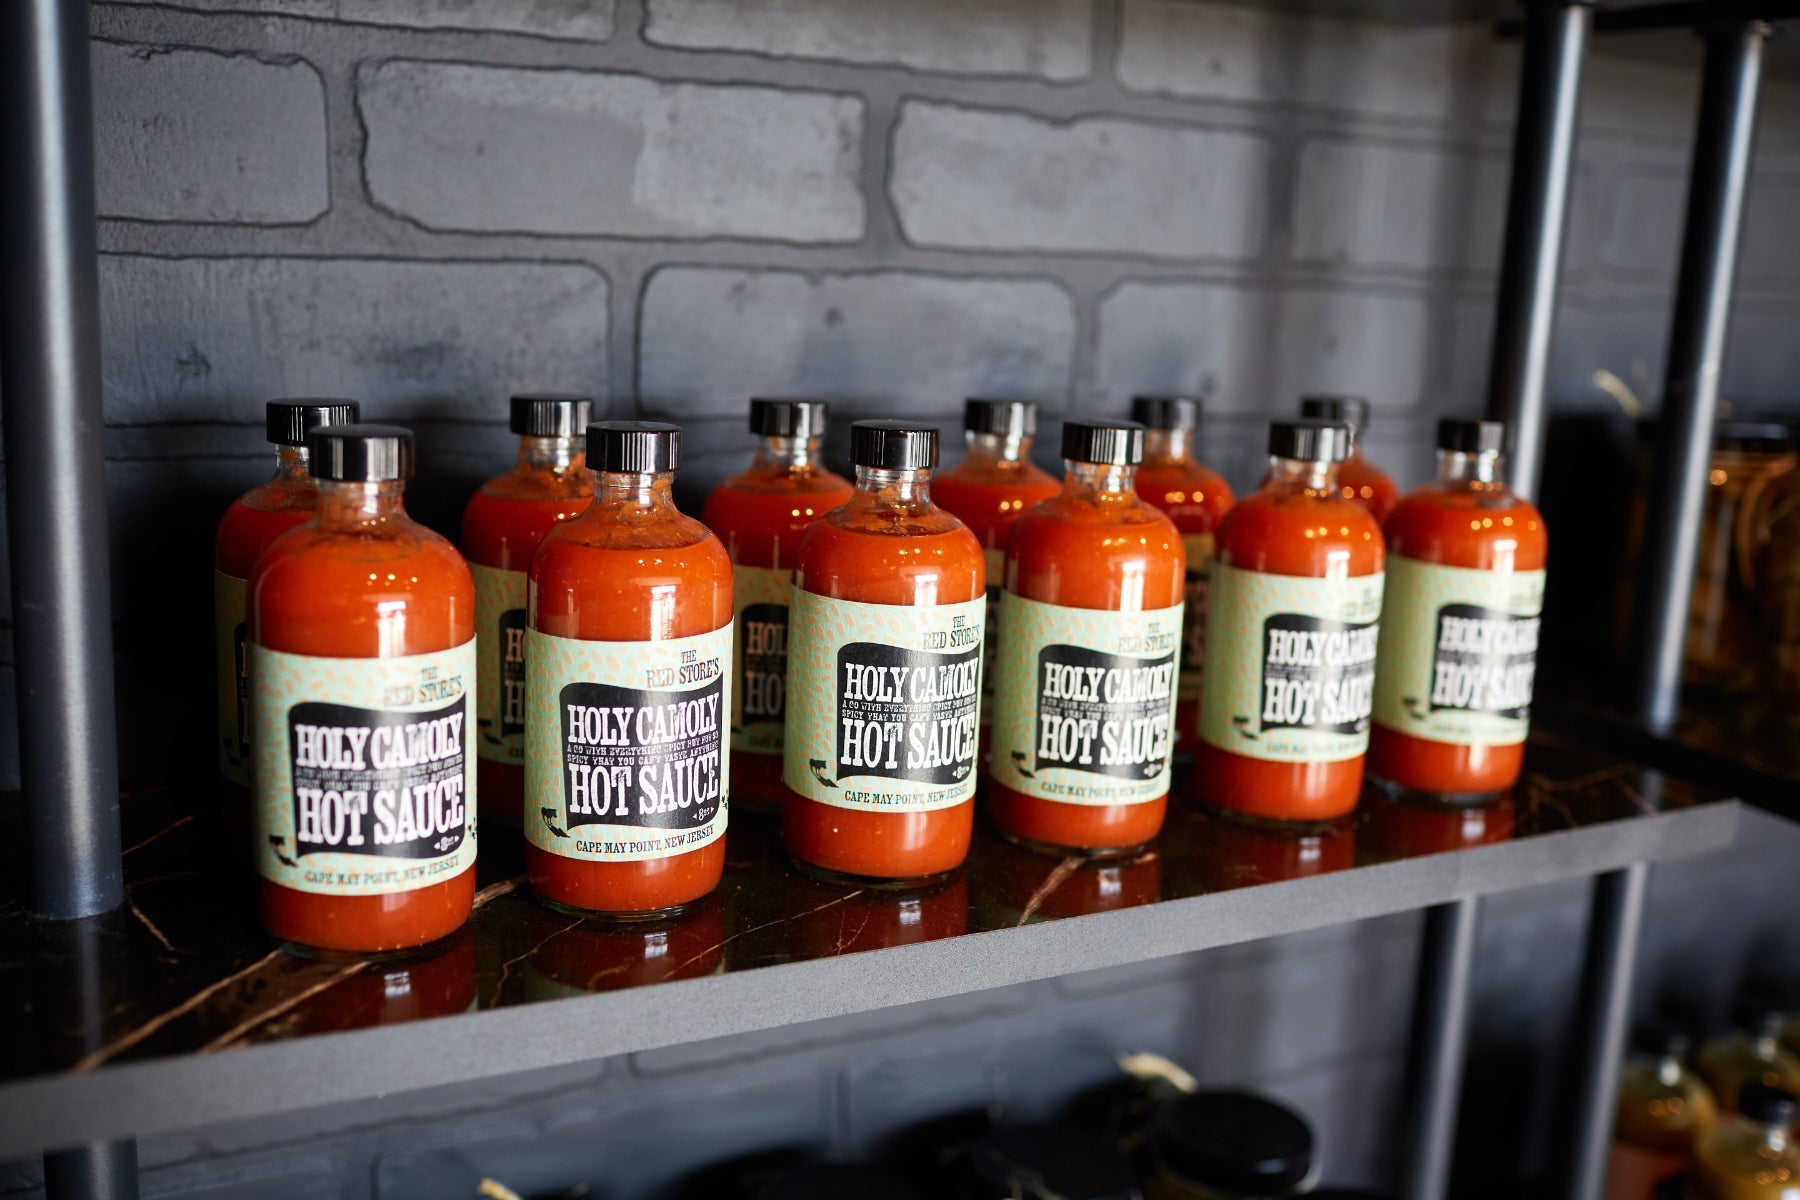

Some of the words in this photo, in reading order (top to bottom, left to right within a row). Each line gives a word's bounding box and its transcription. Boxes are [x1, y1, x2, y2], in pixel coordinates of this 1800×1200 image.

[922, 631, 947, 650] RED
[952, 615, 966, 628] THE
[680, 649, 697, 664] THE
[1267, 628, 1329, 666] HOLY
[646, 667, 675, 689] RED
[679, 656, 719, 685] STORE'S
[843, 662, 910, 703] HOLY
[910, 657, 979, 703] CAMOLY
[1042, 661, 1105, 702] HOLY
[1104, 661, 1173, 704] CAMOLY
[1432, 660, 1487, 709] HOT
[567, 704, 634, 747] HOLY
[635, 692, 720, 746] CAMOLY
[841, 709, 865, 720] SPICY
[891, 713, 907, 722] YOU
[842, 699, 848, 708] A
[1263, 676, 1322, 725] HOT
[294, 724, 371, 770] HOLY
[370, 711, 464, 770] CAMOLY
[567, 743, 572, 753] A
[663, 740, 686, 753] SPICY
[840, 717, 904, 769] HOT
[907, 711, 976, 769] SAUCE
[1038, 713, 1099, 765] HOT
[1100, 713, 1170, 766] SAUCE
[567, 753, 589, 765] SPICY
[617, 756, 635, 766] YOU
[568, 763, 632, 816] HOT
[638, 749, 719, 816] SAUCE
[845, 790, 870, 804] CAPE
[872, 792, 893, 805] MAY
[927, 789, 945, 803] NEW
[297, 787, 368, 846] HOT
[373, 773, 464, 845] SAUCE
[576, 840, 602, 853] CAPE
[605, 842, 627, 854] MAY
[629, 839, 662, 853] POINT,
[664, 834, 687, 849] NEW
[686, 823, 714, 844] JERSEY
